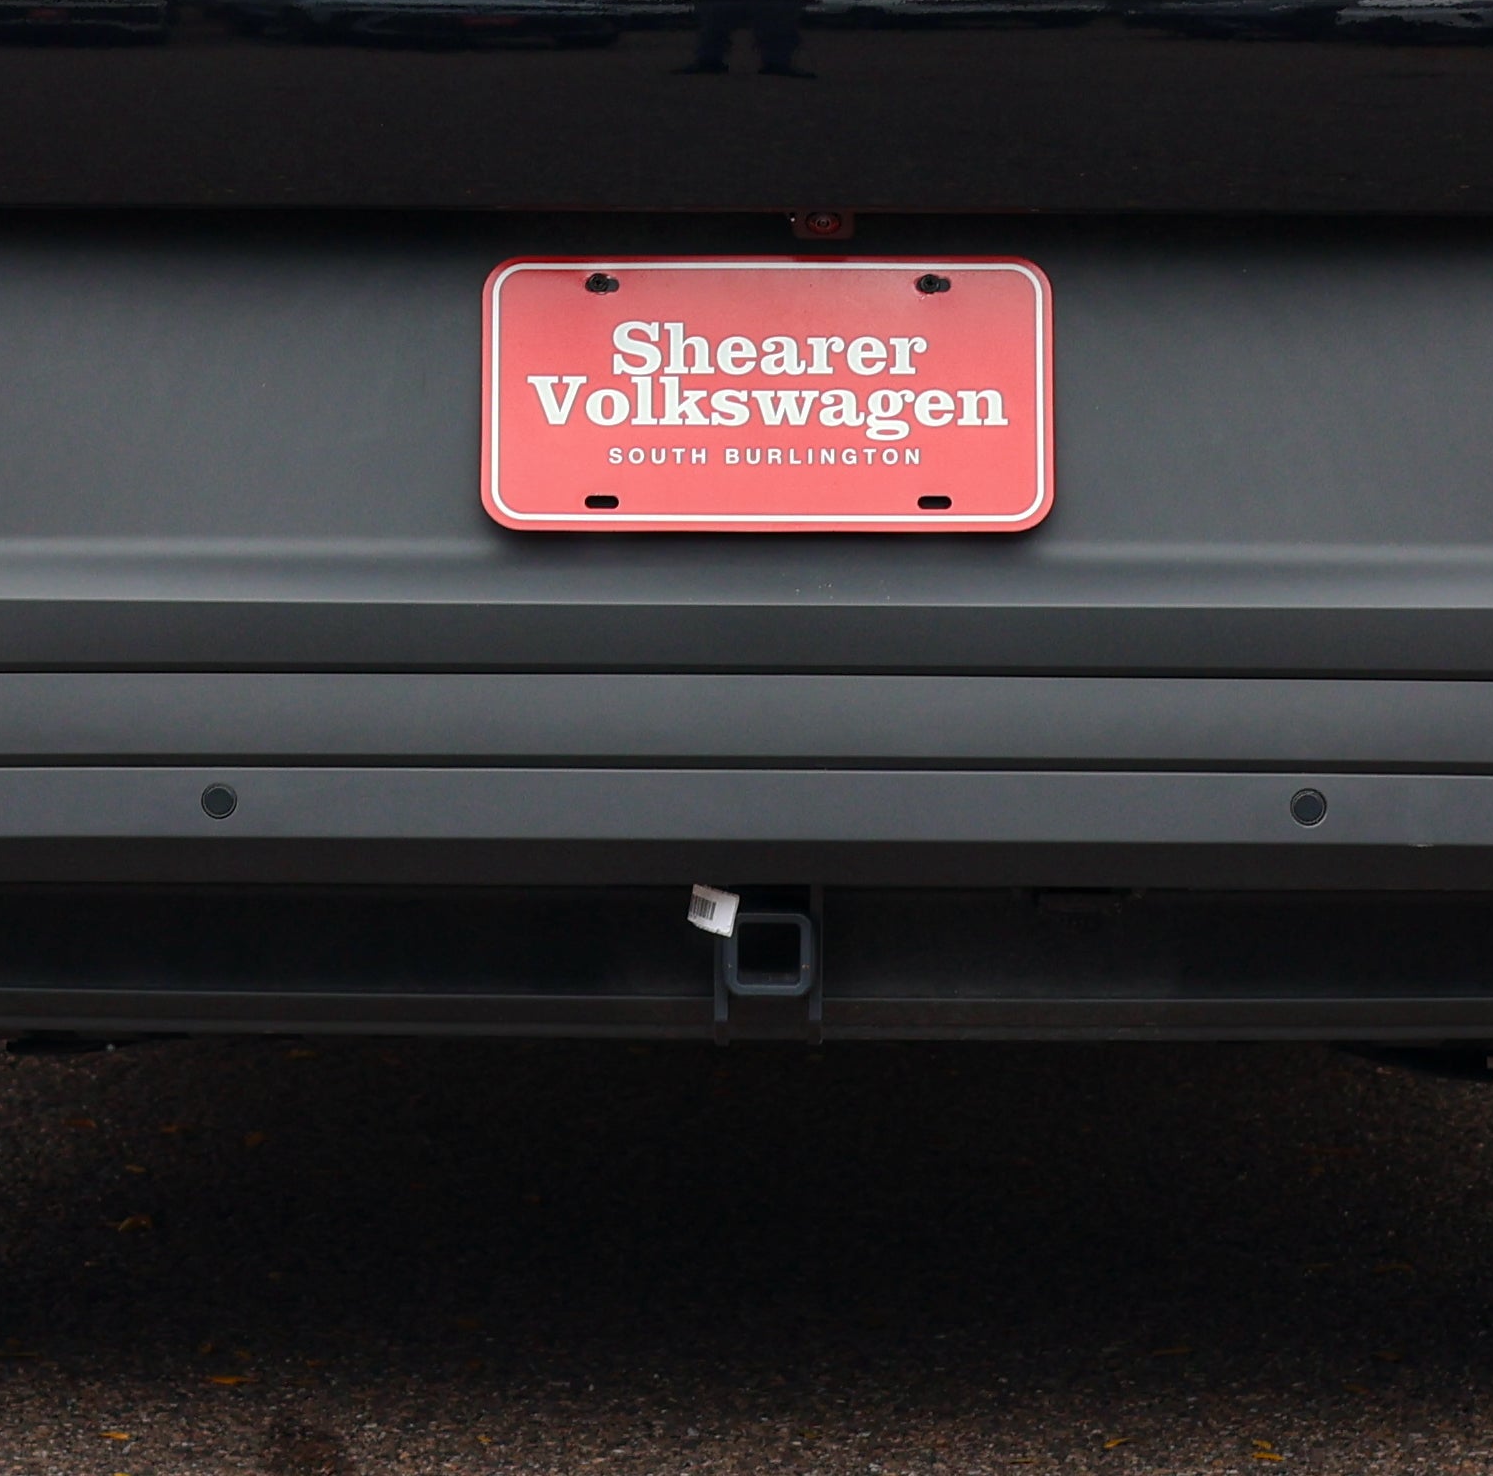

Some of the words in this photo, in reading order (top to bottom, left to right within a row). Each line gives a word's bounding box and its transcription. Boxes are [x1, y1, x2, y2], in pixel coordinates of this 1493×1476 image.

[611, 320, 928, 376] Shearer
[527, 375, 1009, 441] Volkswagen
[608, 447, 708, 465] SOUTH
[724, 447, 922, 466] BURLINGTON
